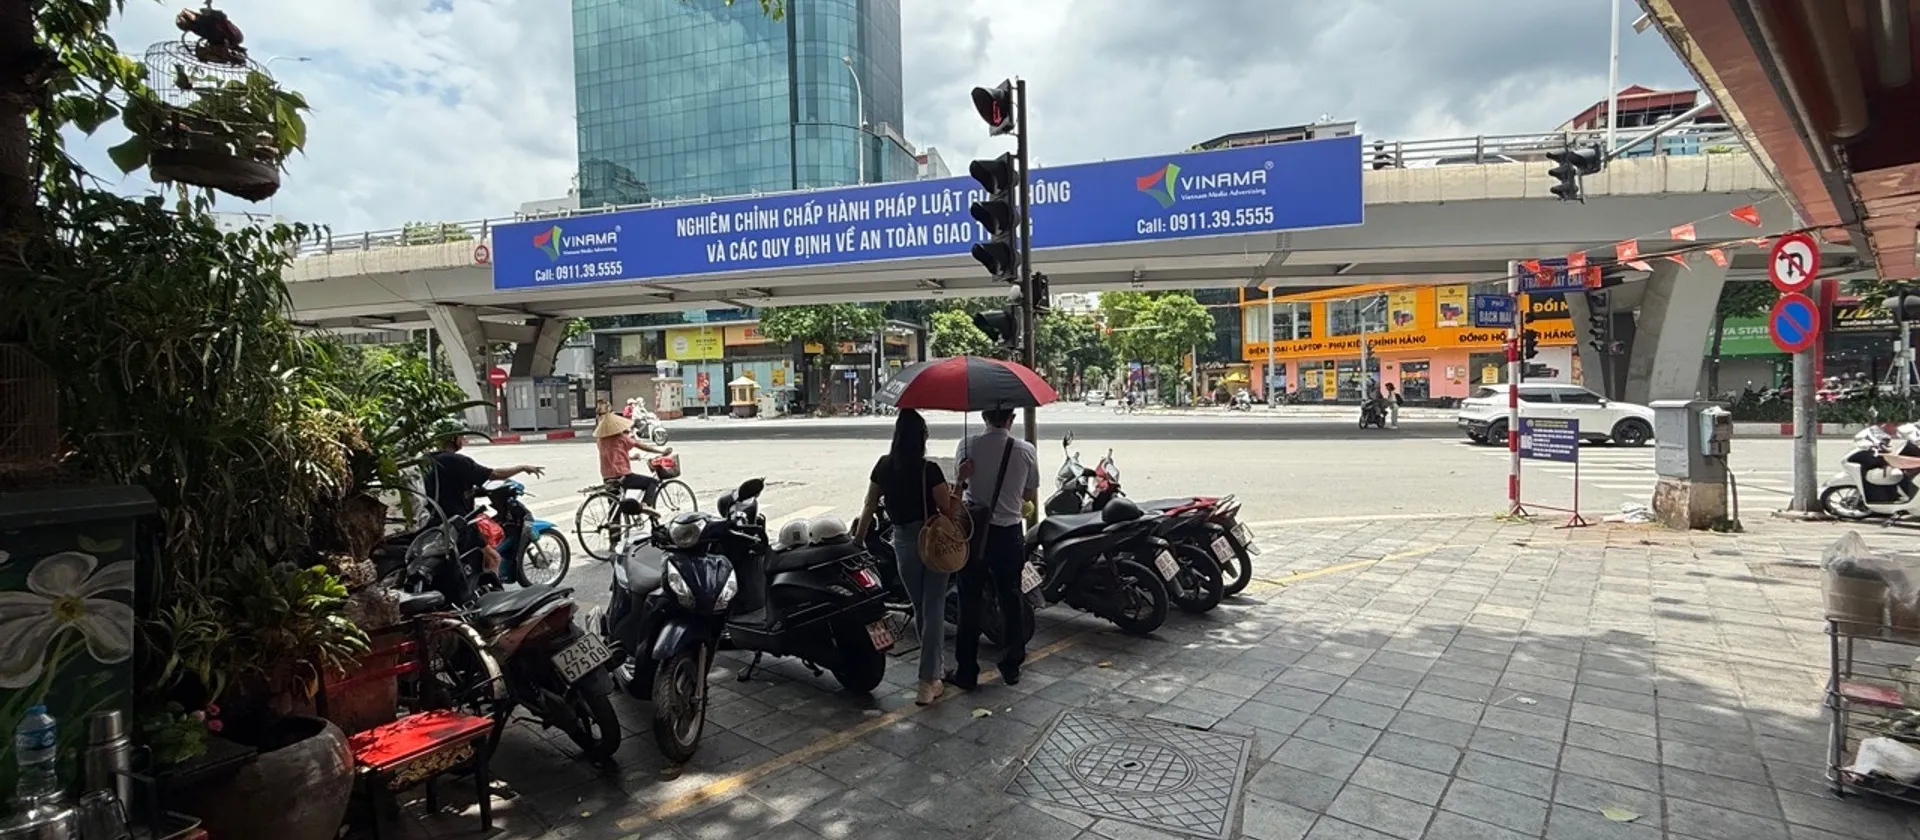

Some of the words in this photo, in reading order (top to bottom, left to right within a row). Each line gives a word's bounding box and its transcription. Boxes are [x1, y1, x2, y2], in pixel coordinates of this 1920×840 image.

[1181, 169, 1267, 191] VINAMA
[676, 211, 731, 237] NGHIÊM
[734, 206, 779, 231] CHỈNH
[783, 200, 823, 228] CHẤP
[827, 199, 870, 223] HÀNH
[875, 193, 917, 218] PHÁP
[921, 188, 962, 217] LUẬT
[1136, 218, 1167, 234] Call:
[1169, 206, 1274, 232] 0911.39.5555
[562, 232, 618, 248] VINAMA
[706, 239, 726, 263] VÀ
[730, 237, 758, 261] CÁC
[762, 237, 791, 259] QUY
[794, 234, 830, 259] ĐỊNH
[835, 225, 856, 252] VỀ
[860, 228, 880, 250] AN
[885, 223, 928, 248] TOÀN
[932, 221, 971, 244] GIAO
[535, 269, 555, 282] Call:
[555, 261, 623, 280] 0911.39.5555
[1479, 310, 1498, 324] BẠCH
[1293, 343, 1323, 352] LAPTOP
[1329, 341, 1346, 350] PHỤ
